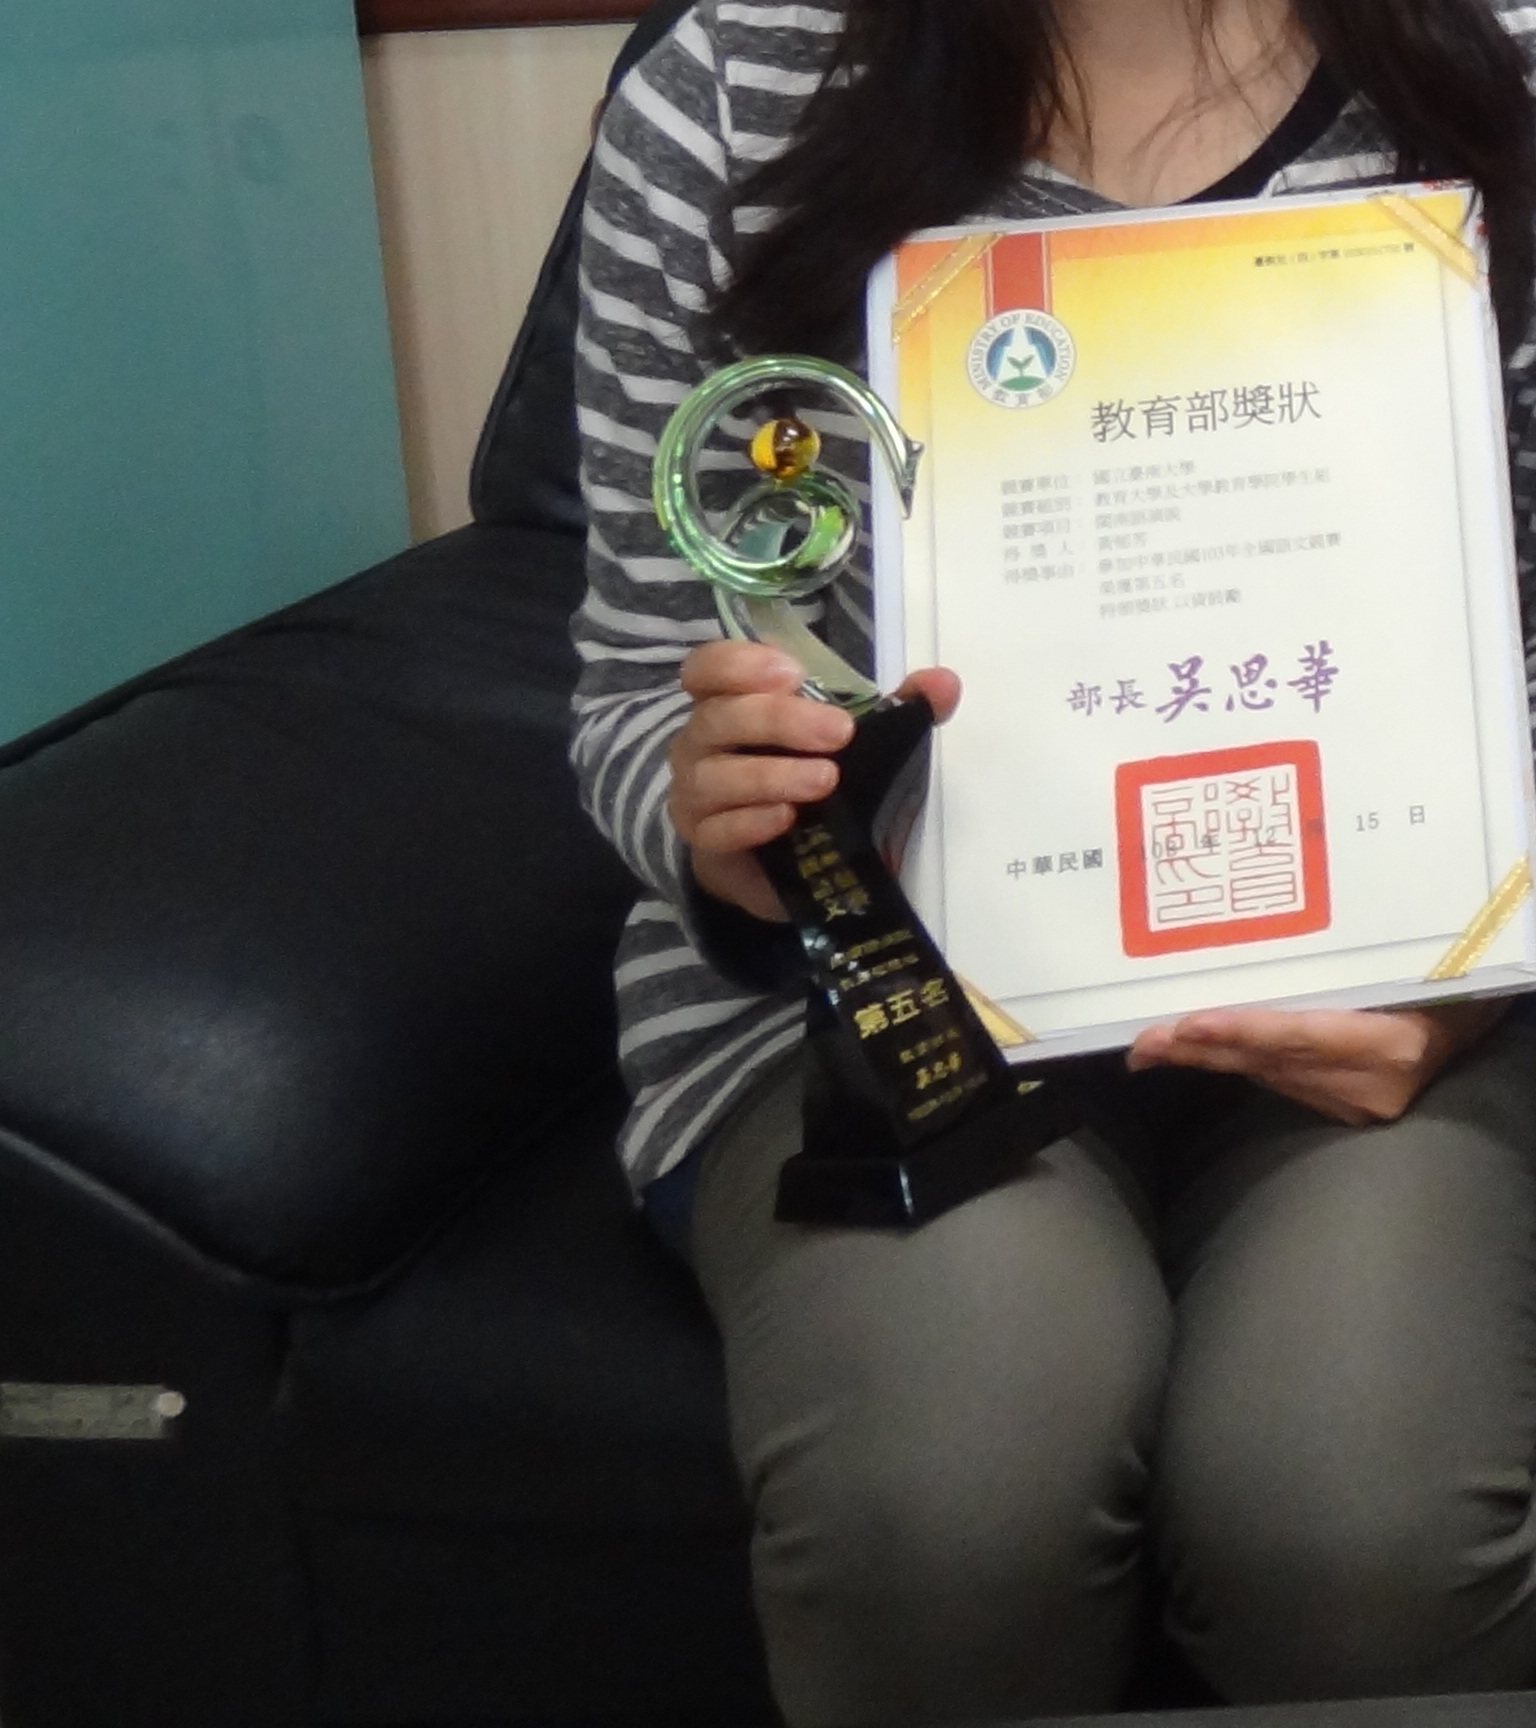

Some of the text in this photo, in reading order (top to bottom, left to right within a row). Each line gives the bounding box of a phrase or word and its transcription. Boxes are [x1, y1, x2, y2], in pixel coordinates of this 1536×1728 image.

[1092, 381, 1323, 445] 教育部獎狀
[1065, 639, 1340, 723] 部長 吳思華
[1005, 846, 1104, 880] 中華民國
[1355, 811, 1380, 833] 15
[1408, 804, 1426, 825] 日
[853, 978, 950, 1039] 第五名
